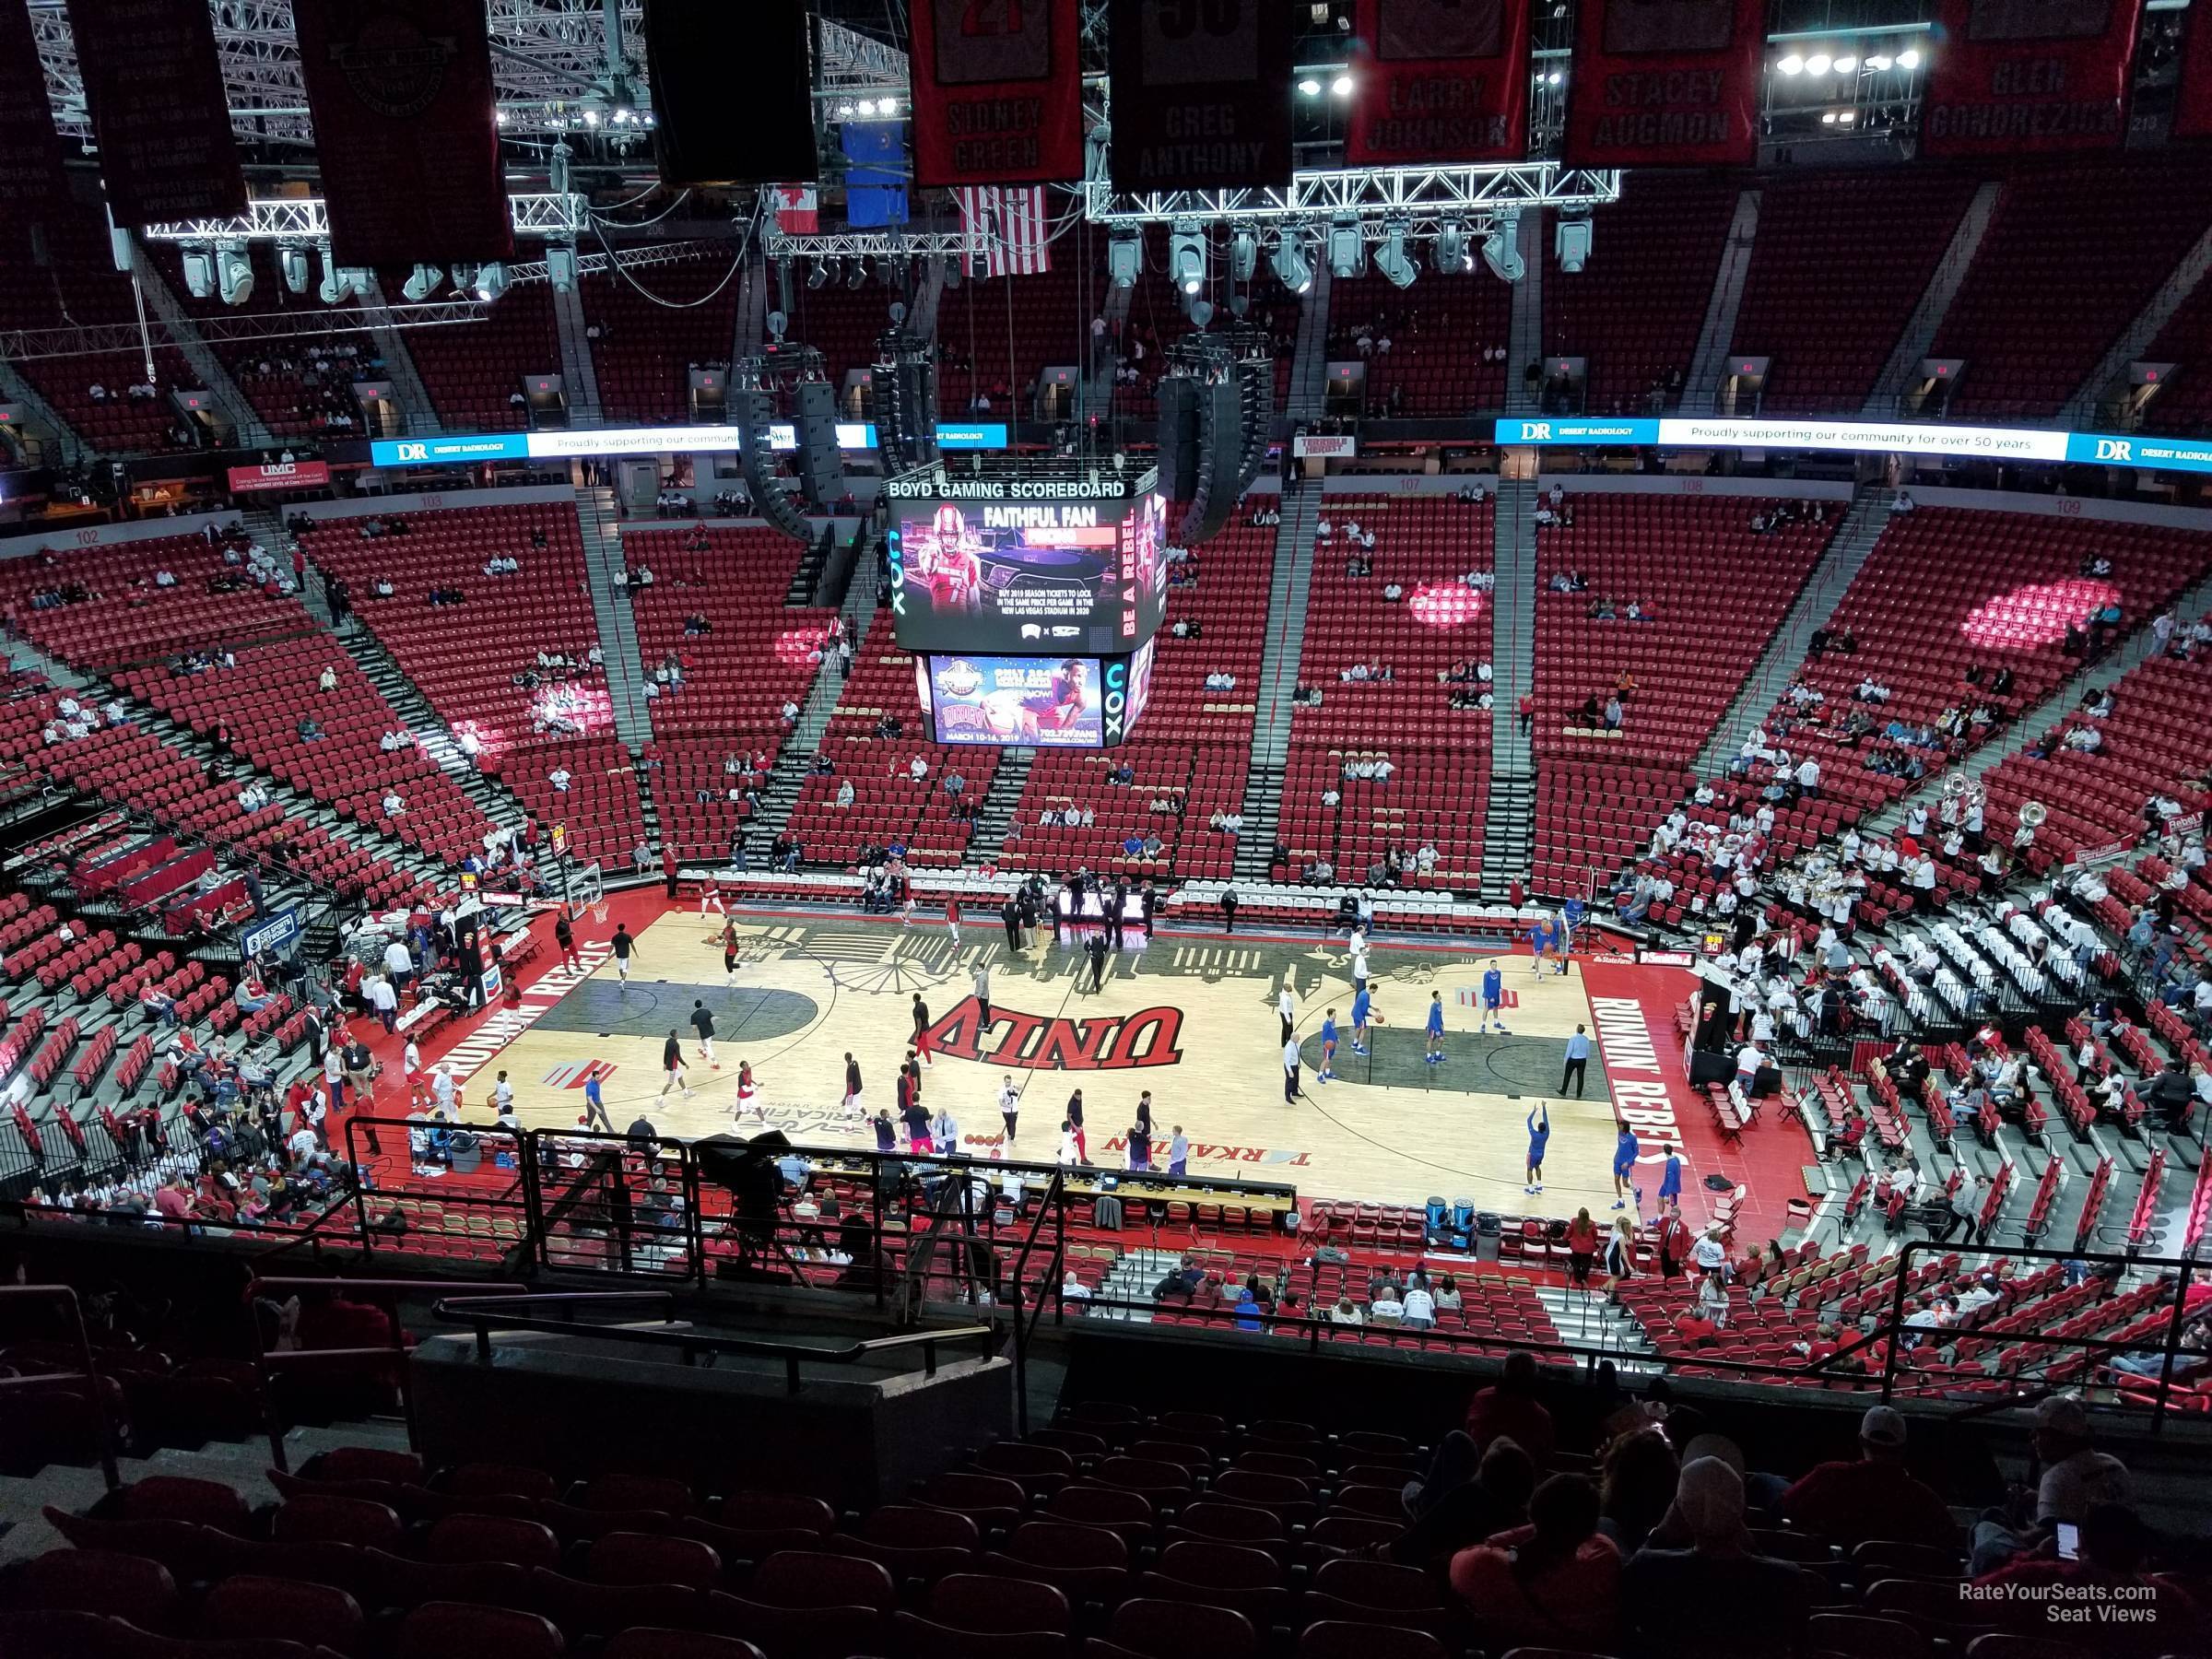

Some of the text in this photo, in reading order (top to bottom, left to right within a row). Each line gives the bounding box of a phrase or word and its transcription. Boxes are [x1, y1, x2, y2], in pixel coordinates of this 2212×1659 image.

[1992, 58, 2066, 94] GLEN
[1389, 73, 1487, 112] LARRY
[1606, 71, 1724, 107] STACEY
[947, 99, 1041, 135] SIDNEY
[1165, 103, 1237, 139] GREG
[1366, 114, 1508, 151] JOHNSON
[1594, 112, 1730, 147] AUGMON
[953, 137, 1039, 171] GREEN
[1137, 141, 1267, 178] ANTHONY
[1521, 422, 1551, 440] DR
[1691, 428, 2031, 450] Proudly supporting our community for over 50 years
[396, 443, 429, 461] DR
[462, 443, 504, 452] RADIOLOGY
[557, 439, 600, 450] Proudly
[603, 436, 663, 448] supporting
[688, 434, 738, 444] communi
[2095, 440, 2132, 461] DR
[2141, 448, 2175, 458] DESERT
[260, 464, 296, 476] UMC
[889, 482, 932, 498] BOYD
[939, 482, 1004, 498] GAMING
[1010, 482, 1124, 498] SCOREBOARD
[1401, 478, 1420, 490] 107
[1682, 479, 1702, 491] 108
[419, 495, 442, 508] 103
[2056, 500, 2080, 514] 109
[983, 506, 1097, 527] FAITHFUL FAN
[76, 530, 99, 545] 102
[1122, 508, 1135, 636] BE A REBEL.
[949, 576, 962, 603] 7
[1015, 598, 1030, 606] SAME
[1030, 598, 1046, 606] PRICE
[1047, 598, 1057, 606] PER
[1057, 598, 1074, 606] GAME
[1076, 598, 1082, 606] IN
[1083, 598, 1094, 606] THE
[1106, 663, 1124, 736] COX
[942, 704, 985, 728] UNLV
[946, 733, 1019, 743] MARCH 10-16, 2019
[2169, 815, 2196, 829] Rebel
[2100, 841, 2122, 853] Place
[259, 919, 291, 939] CBS SPORTS
[260, 928, 288, 946] NETWORK
[1707, 943, 1718, 951] 30
[911, 994, 1184, 1070] UNLV
[1592, 996, 1689, 1166] RUNNIN' REBELS
